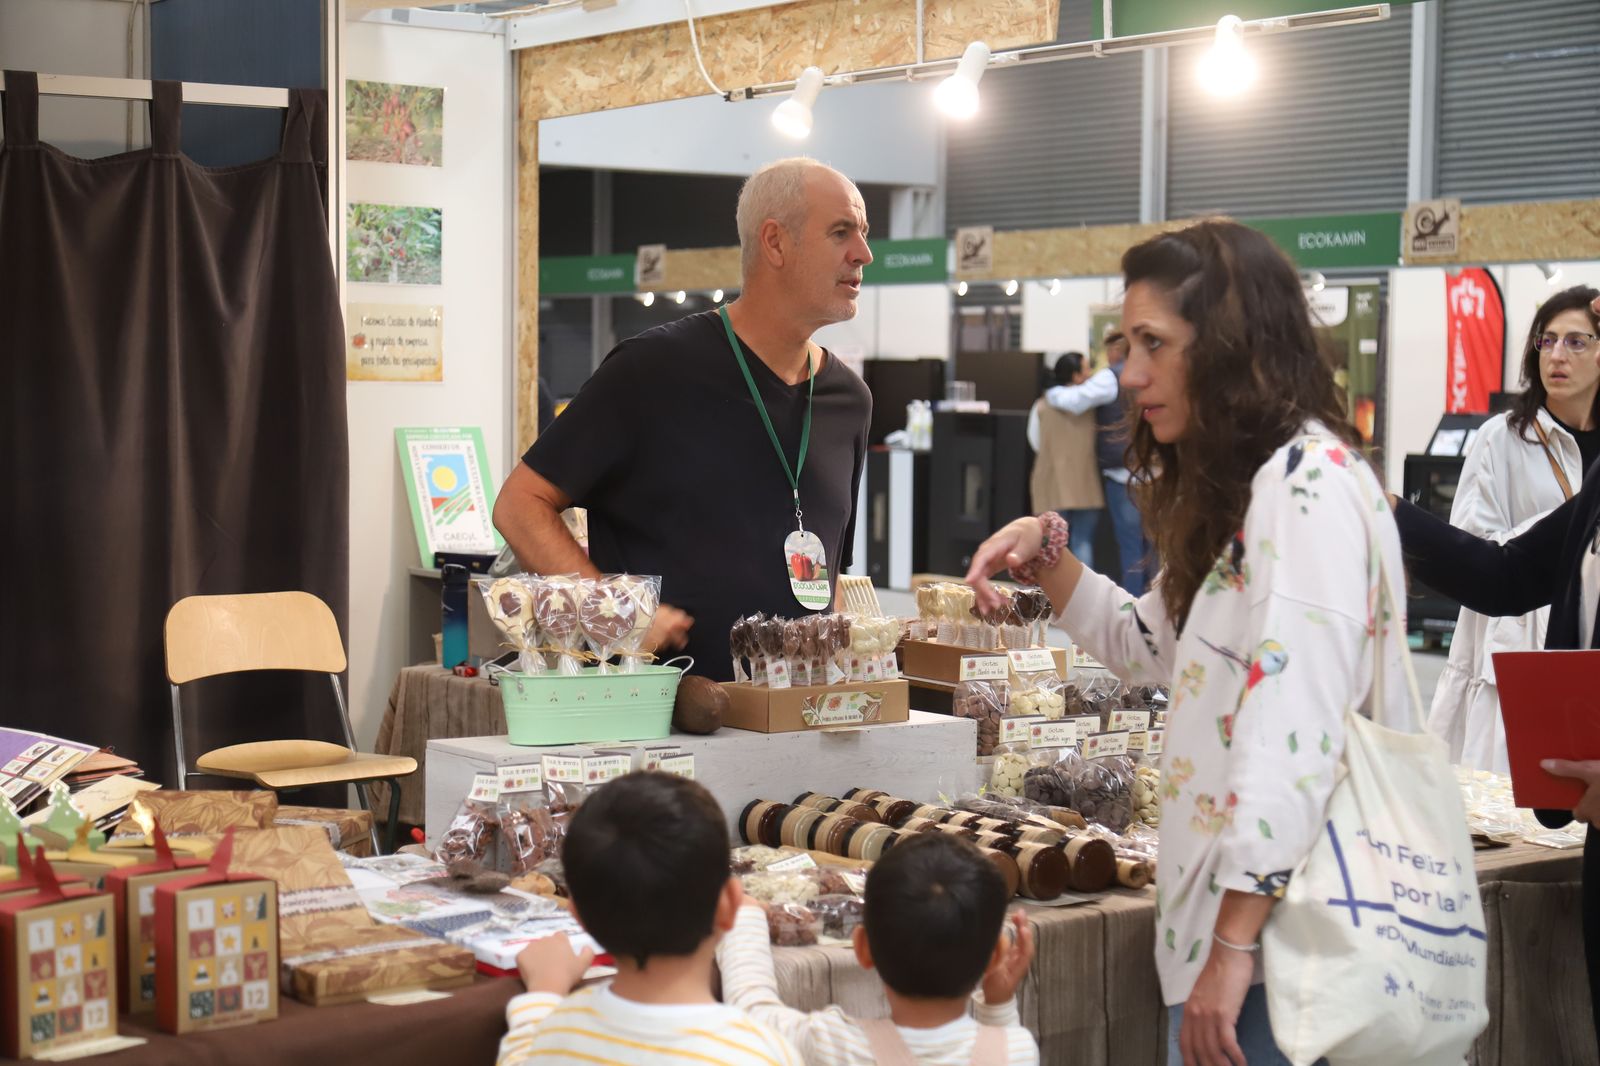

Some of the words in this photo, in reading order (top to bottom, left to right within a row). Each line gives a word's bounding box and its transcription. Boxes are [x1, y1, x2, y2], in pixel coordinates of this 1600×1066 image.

[1297, 230, 1367, 248] ECOKAMIN
[1396, 844, 1449, 876] Feliz
[1391, 880, 1432, 906] por
[1437, 891, 1457, 913] la
[247, 989, 265, 1007] 12
